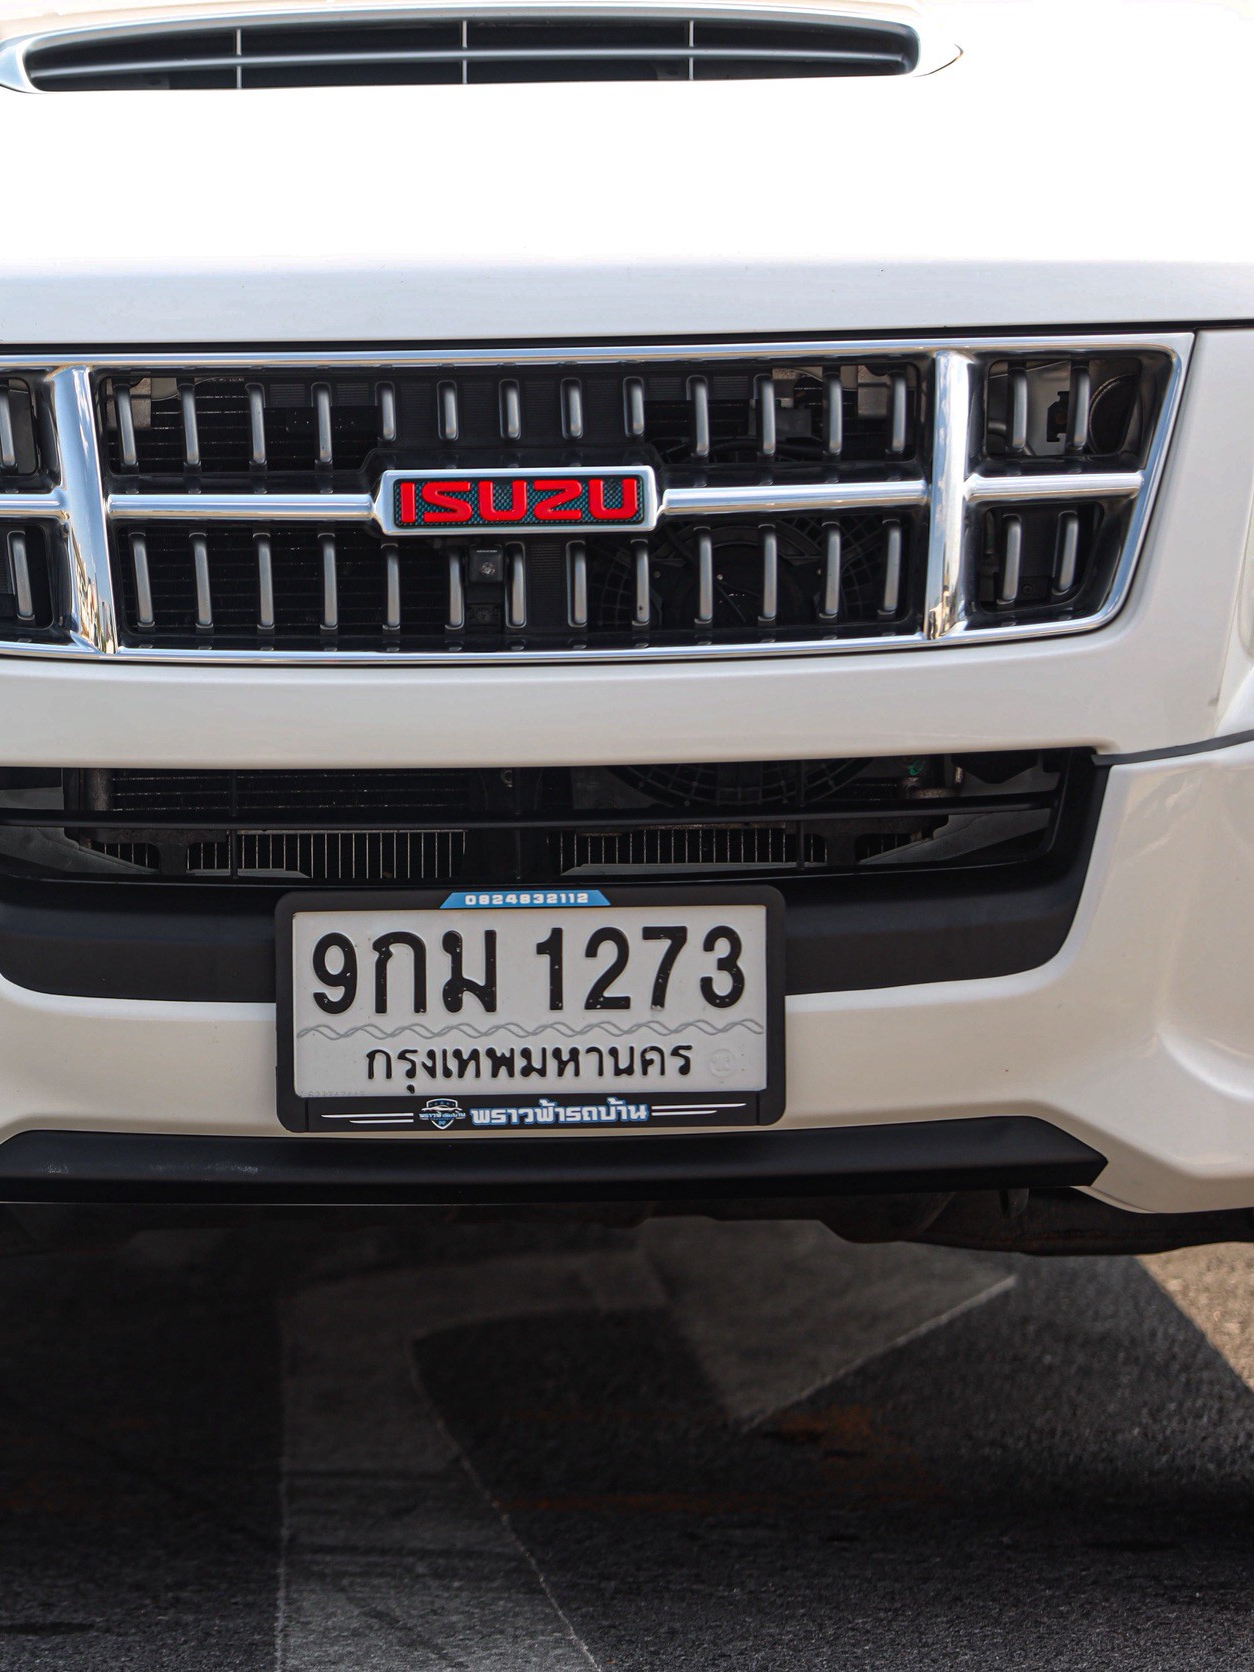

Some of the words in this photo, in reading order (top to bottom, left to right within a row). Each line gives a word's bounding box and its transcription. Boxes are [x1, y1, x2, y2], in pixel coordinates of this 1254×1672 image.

[400, 479, 638, 523] ISUZU
[464, 893, 589, 905] 0824832112
[312, 929, 497, 1014] 9กม
[535, 925, 746, 1012] 1273
[365, 1043, 694, 1094] กรุงเทพมหานคร
[469, 1097, 649, 1125] พราวฟ้ารถบ้าน
